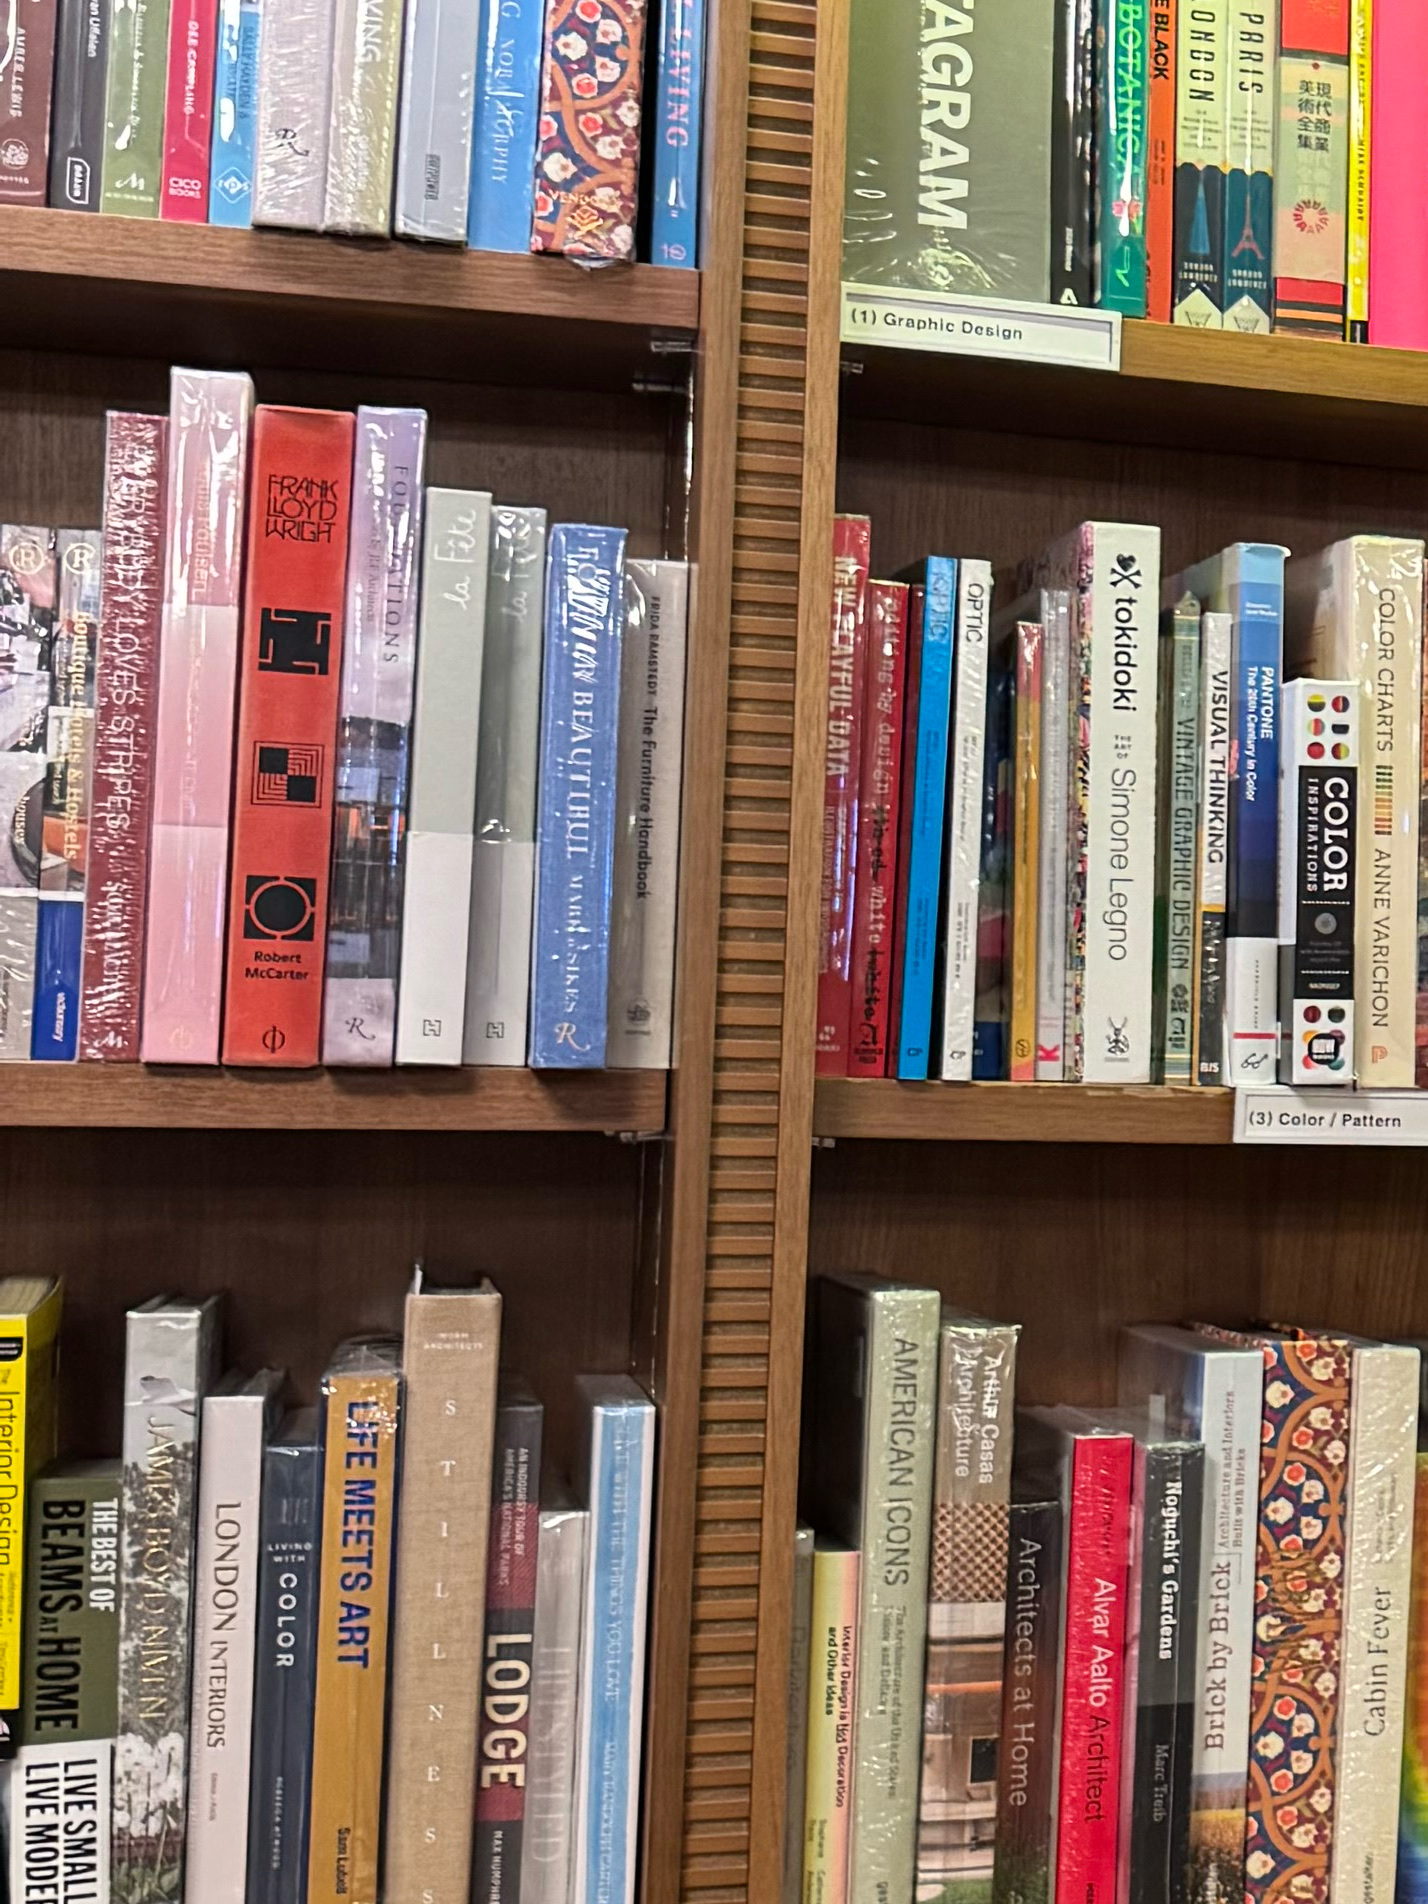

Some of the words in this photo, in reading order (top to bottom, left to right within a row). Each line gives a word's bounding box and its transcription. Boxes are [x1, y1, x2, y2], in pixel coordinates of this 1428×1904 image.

[1238, 12, 1264, 95] PARIS
[851, 307, 877, 326] (1)
[882, 311, 956, 335] Graphic
[961, 319, 1024, 341] Design
[267, 473, 339, 499] FRANK
[267, 498, 338, 521] LLOYD
[1111, 597, 1139, 712] tokidoki
[1378, 587, 1396, 663] COLOR
[1210, 670, 1229, 758] VISUAL
[1259, 666, 1275, 740] PANTONE
[1374, 669, 1394, 753] CHARTS
[1109, 769, 1137, 870] Simone
[1206, 761, 1226, 865] THINKING
[1323, 776, 1349, 892] COLOR
[1103, 875, 1132, 962] Legno
[1373, 847, 1391, 911] ANNE
[244, 967, 310, 982] McCarter
[252, 950, 303, 965] Robert
[1370, 916, 1391, 1028] VARICHON
[1248, 1109, 1273, 1129] (3)
[1278, 1112, 1324, 1128] Color
[1341, 1112, 1401, 1129] Pattern
[343, 1400, 381, 1468] LIFE
[885, 1338, 918, 1487] AMERICAN
[207, 1502, 242, 1634] LONDON
[340, 1477, 377, 1591] MEETS
[882, 1492, 912, 1587] ICONS
[336, 1596, 372, 1670] ART
[1010, 1538, 1042, 1680] Architects
[1092, 1577, 1117, 1641] Alvar
[1208, 1560, 1232, 1639] Brick
[1365, 1585, 1392, 1666] Fever
[203, 1639, 229, 1750] INTERIORS
[1009, 1686, 1033, 1714] at
[1087, 1644, 1114, 1708] Aalto
[1205, 1644, 1236, 1677] by
[481, 1632, 533, 1790] LODGE
[1204, 1682, 1229, 1752] Brick
[1362, 1671, 1391, 1739] Cabin
[28, 1763, 61, 1815] LIVE
[65, 1758, 98, 1811] LIVE
[1005, 1719, 1031, 1808] Home
[1082, 1716, 1109, 1824] Architect
